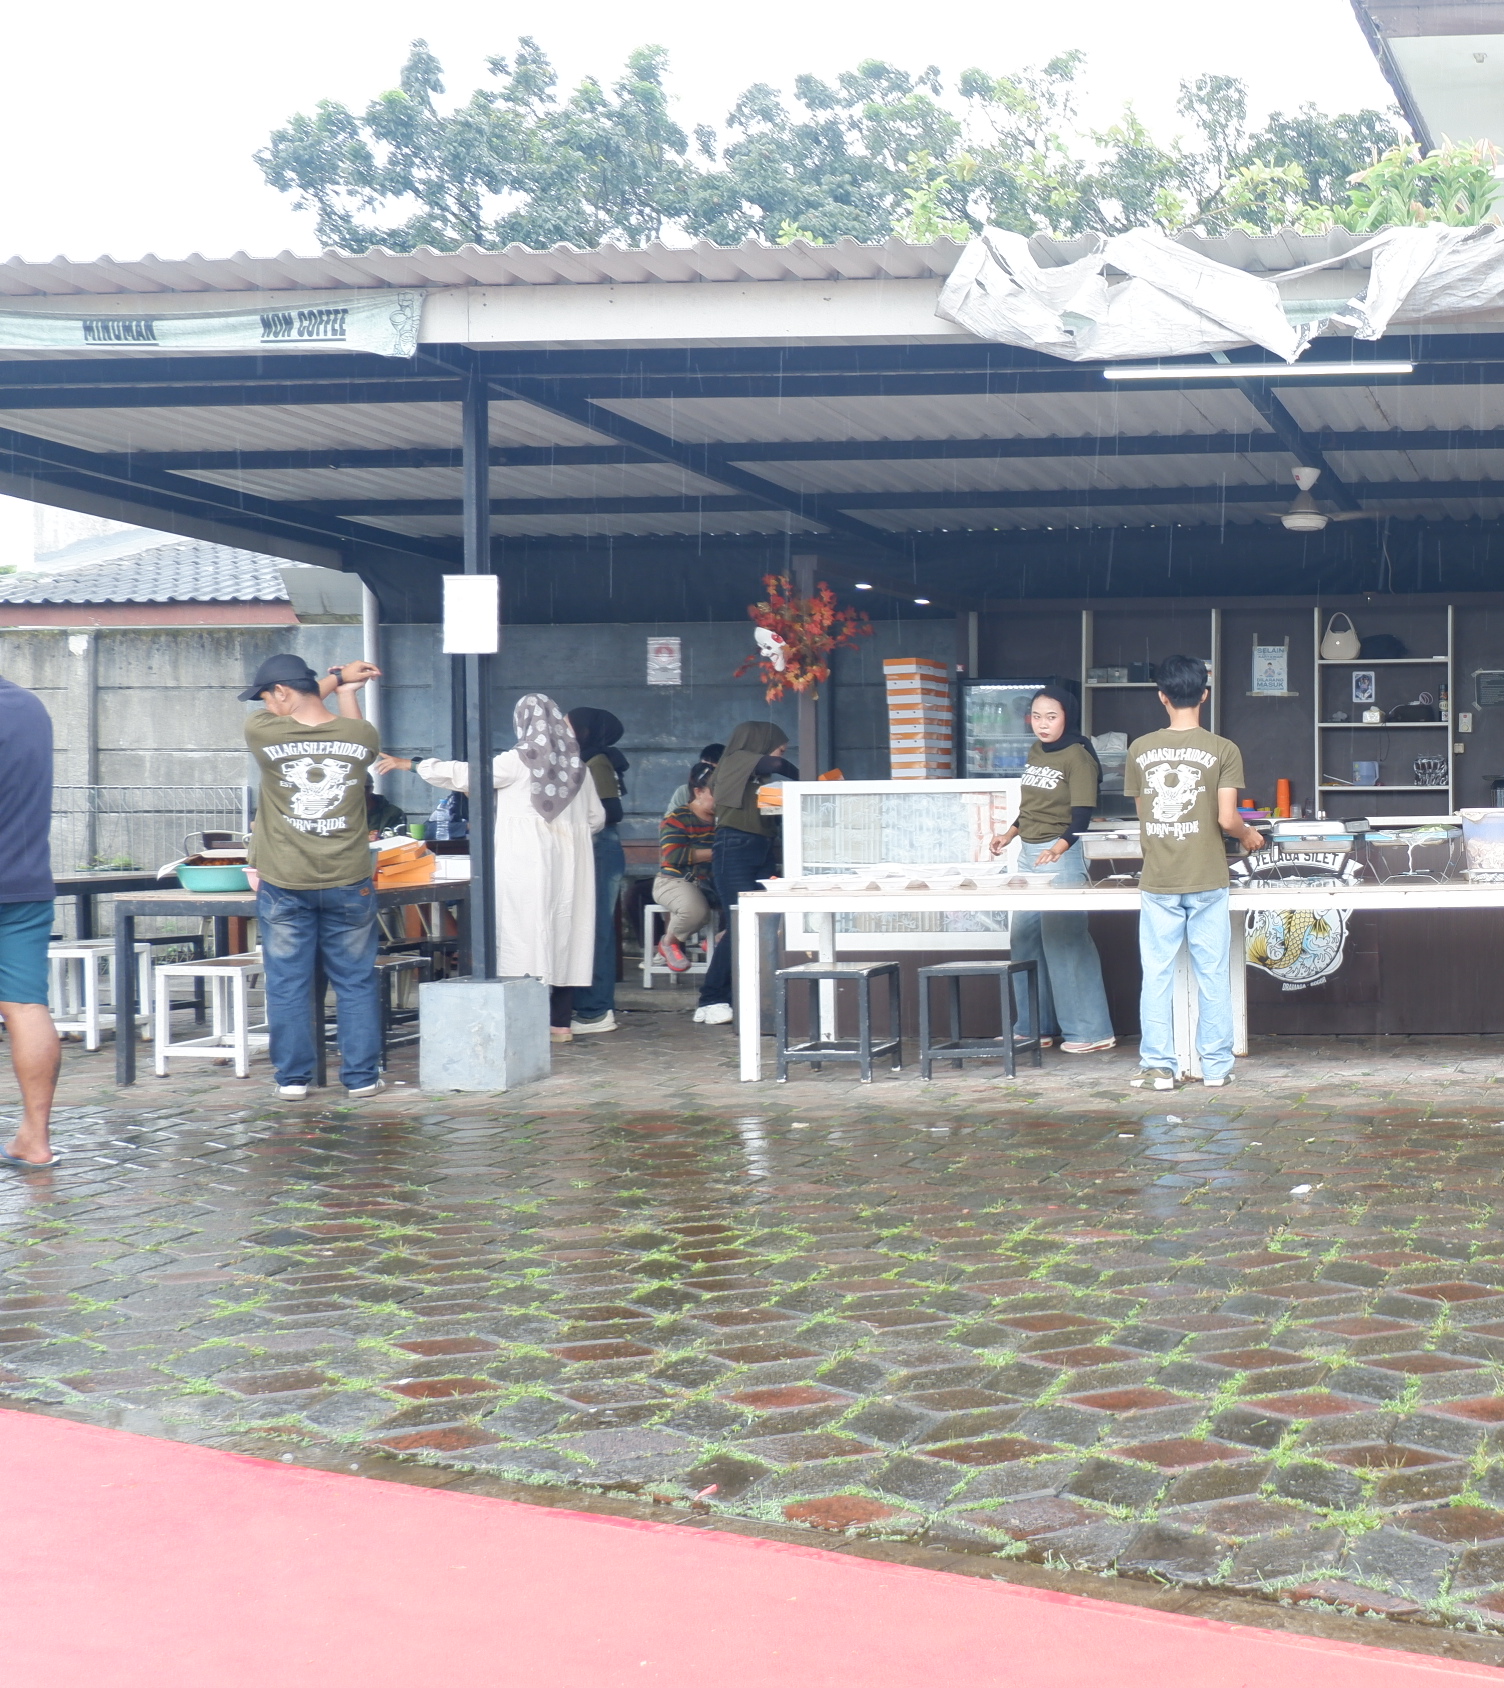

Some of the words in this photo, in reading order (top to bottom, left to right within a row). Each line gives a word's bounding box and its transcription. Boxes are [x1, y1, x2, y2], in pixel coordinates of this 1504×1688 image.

[82, 320, 157, 342] MINUMAN
[260, 312, 295, 338] NON
[297, 308, 349, 337] COFFEE
[262, 740, 368, 761] TELAGASILET-RIDERS
[280, 780, 293, 788] EST
[317, 815, 346, 836] RIDE
[1145, 821, 1169, 838] BORN
[1174, 819, 1200, 841] RIDE
[1304, 852, 1340, 866] SILET
